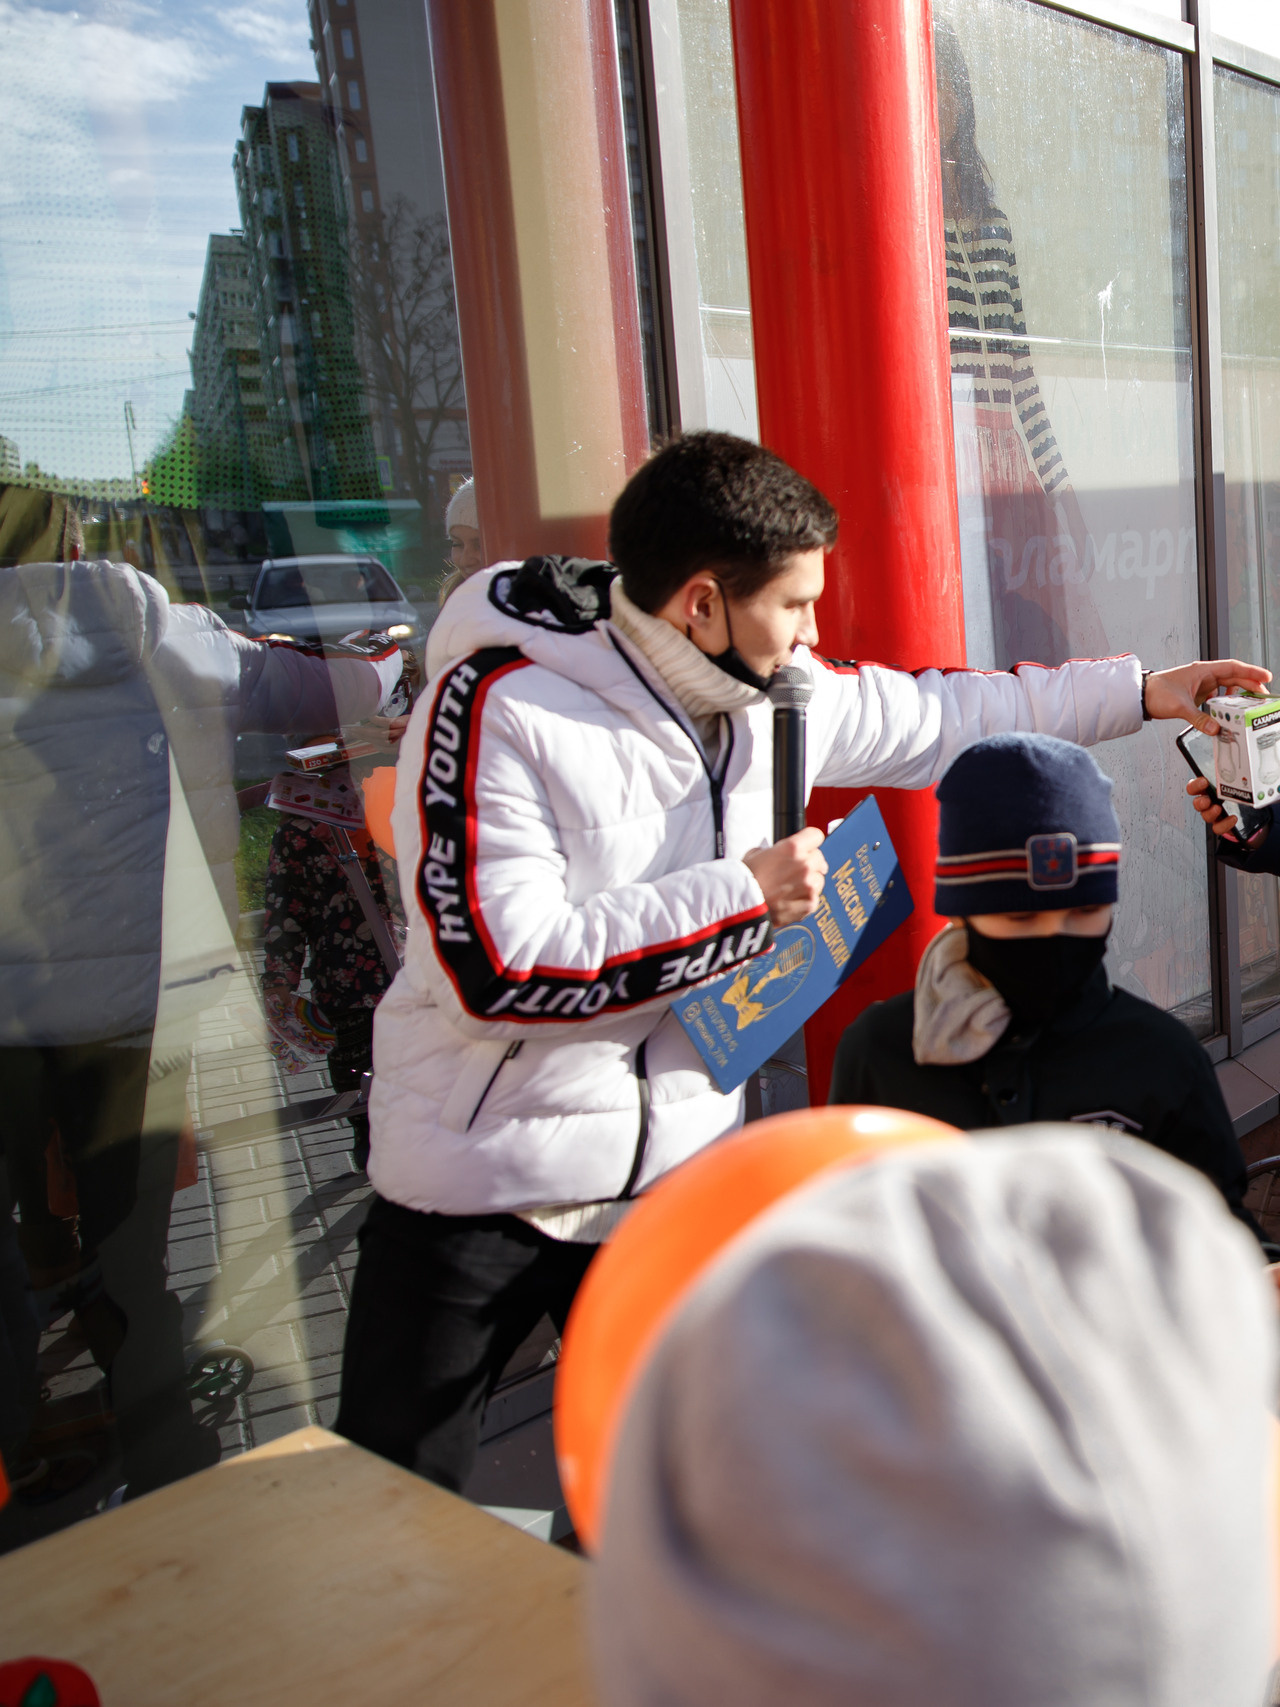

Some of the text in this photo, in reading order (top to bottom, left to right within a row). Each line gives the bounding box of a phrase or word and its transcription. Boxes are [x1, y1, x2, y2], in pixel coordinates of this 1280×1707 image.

[424, 663, 478, 943] HYPE YOUTH
[1221, 785, 1253, 801] САХАРНИЦА
[831, 858, 869, 933] Максим
[855, 843, 888, 909] Ведущий
[655, 920, 770, 993] HYPE
